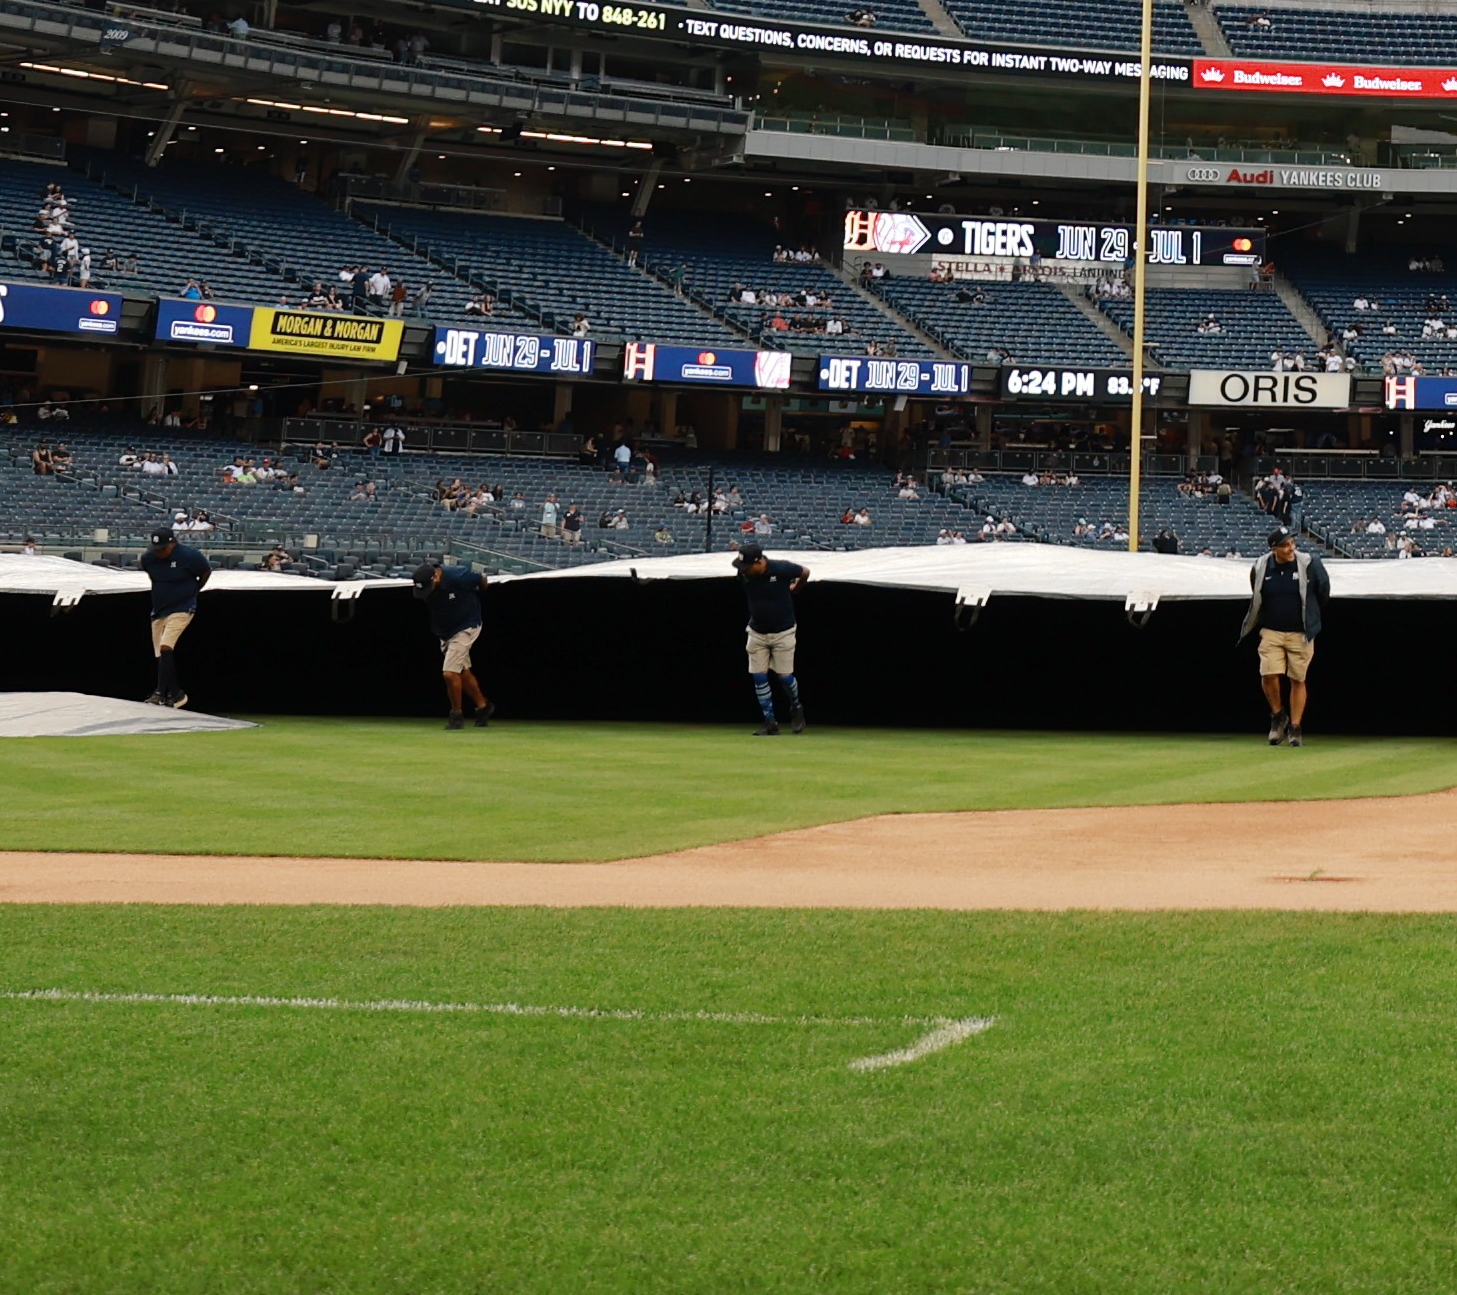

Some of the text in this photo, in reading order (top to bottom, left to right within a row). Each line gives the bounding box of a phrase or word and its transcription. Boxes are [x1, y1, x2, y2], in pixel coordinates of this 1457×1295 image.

[576, 1, 599, 21] TO
[601, 6, 666, 30] 848-261
[104, 29, 130, 41] 2009
[685, 19, 1189, 81] TEXT QUESTIONS, CONCERNS, OR REQUESTS FOR INSTANT TWO-WAY MESAGING
[1226, 169, 1381, 188] Audi YANKEES CLUB
[962, 221, 1201, 265] TIGERS JUN 29 JUL 1
[937, 261, 991, 275] STELLA
[175, 324, 229, 339] yankees.com
[276, 315, 380, 341] MORGAN MORGAN
[350, 344, 361, 352] LAW
[445, 329, 580, 371] DET JUN 29 JUL
[1008, 370, 1160, 396] 6:24 PM 83.°F
[1220, 373, 1319, 404] ORIS
